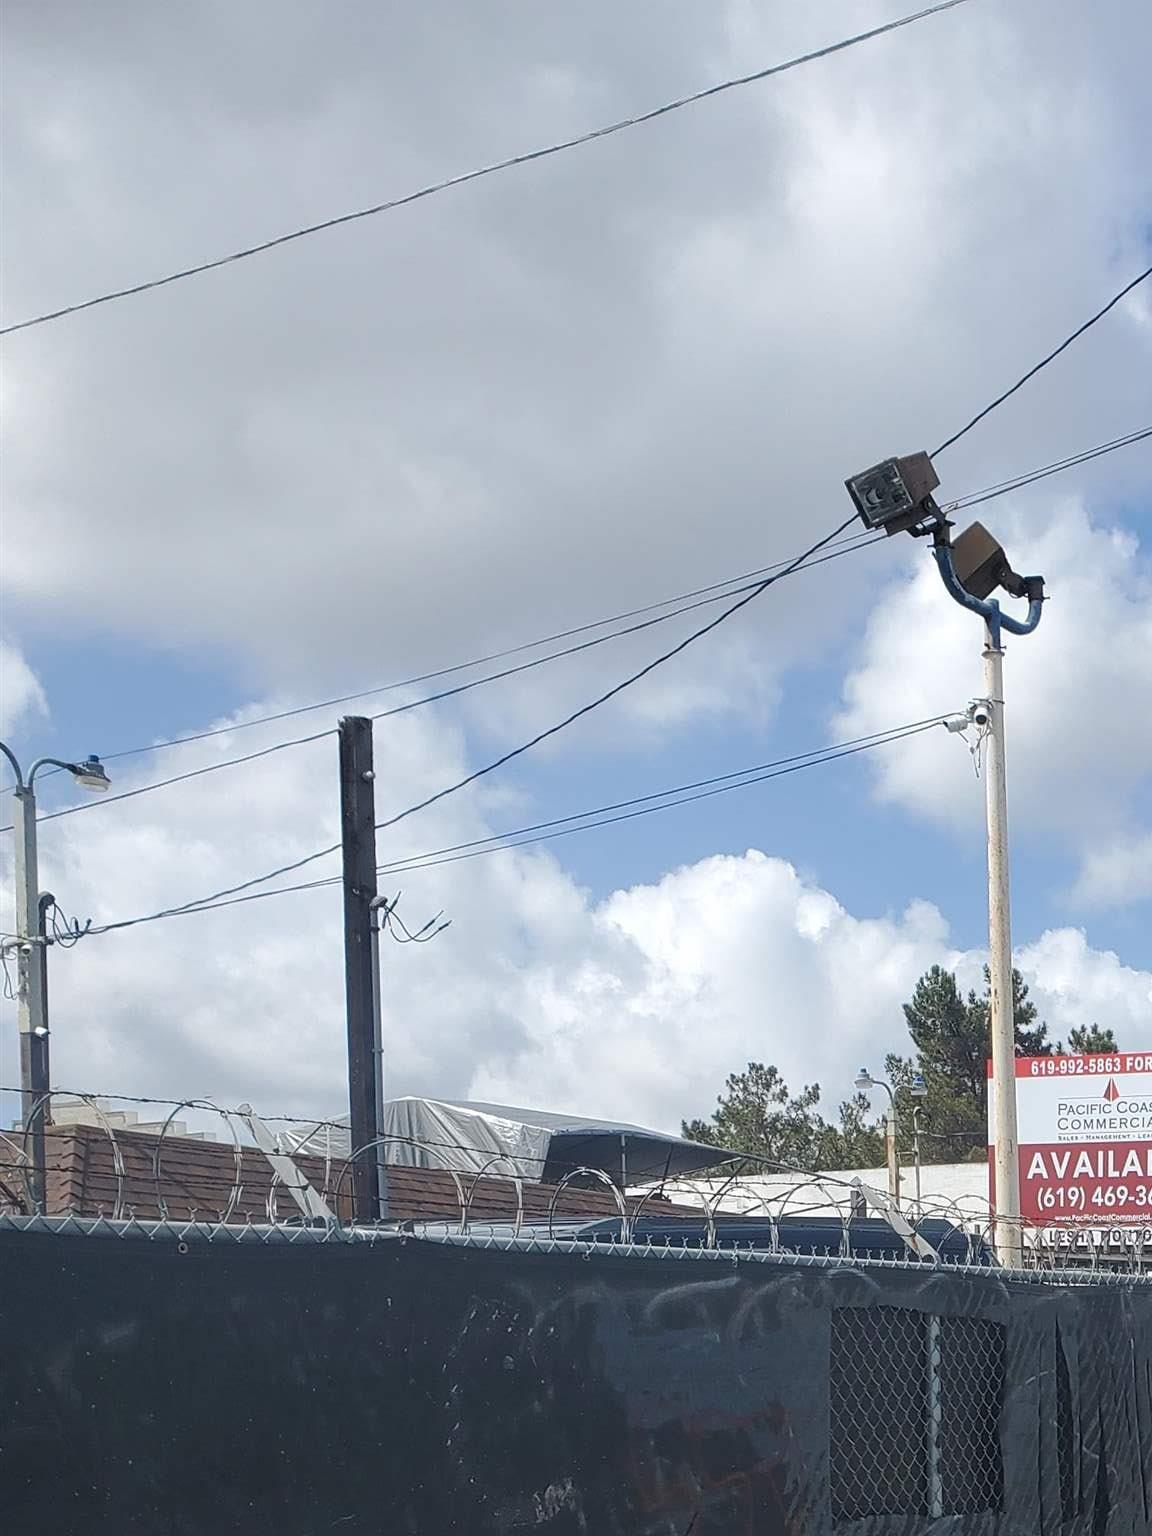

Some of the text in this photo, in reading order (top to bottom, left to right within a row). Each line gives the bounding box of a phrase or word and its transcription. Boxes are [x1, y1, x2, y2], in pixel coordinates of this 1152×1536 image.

[1031, 1058, 1121, 1076] 619-992-5863
[1058, 1103, 1112, 1116] PACIFIC
[1037, 1186, 1085, 1211] (619)
